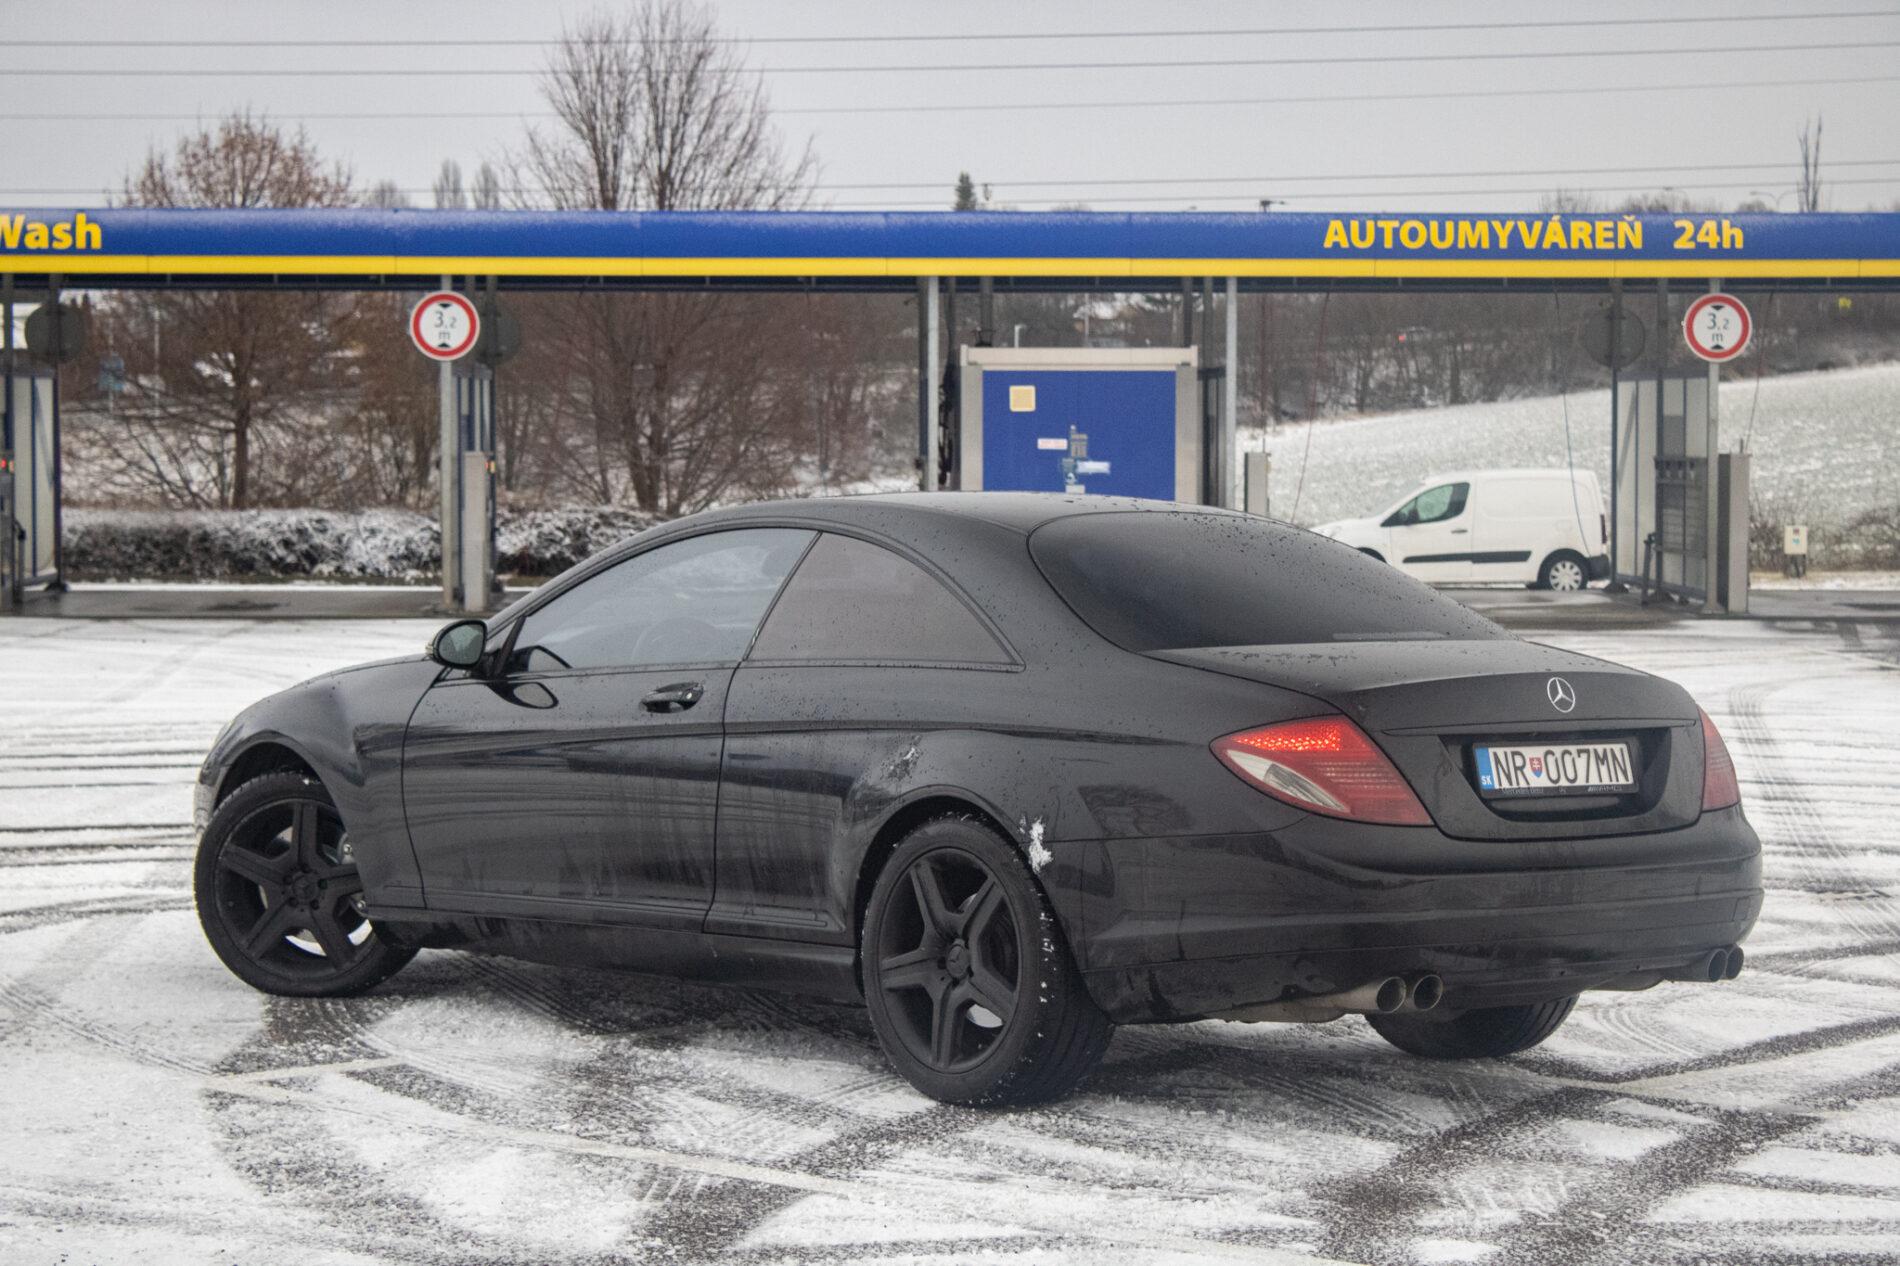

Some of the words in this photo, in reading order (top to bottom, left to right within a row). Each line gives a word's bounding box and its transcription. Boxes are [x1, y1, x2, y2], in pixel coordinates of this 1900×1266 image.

[1323, 215, 1643, 249] AUTOUMYVÁREŇ
[1673, 219, 1743, 249] 24h
[438, 332, 451, 340] m
[1711, 333, 1723, 342] m
[1493, 750, 1531, 787] NR
[1543, 748, 1630, 785] 007MN
[1480, 775, 1493, 786] SK
